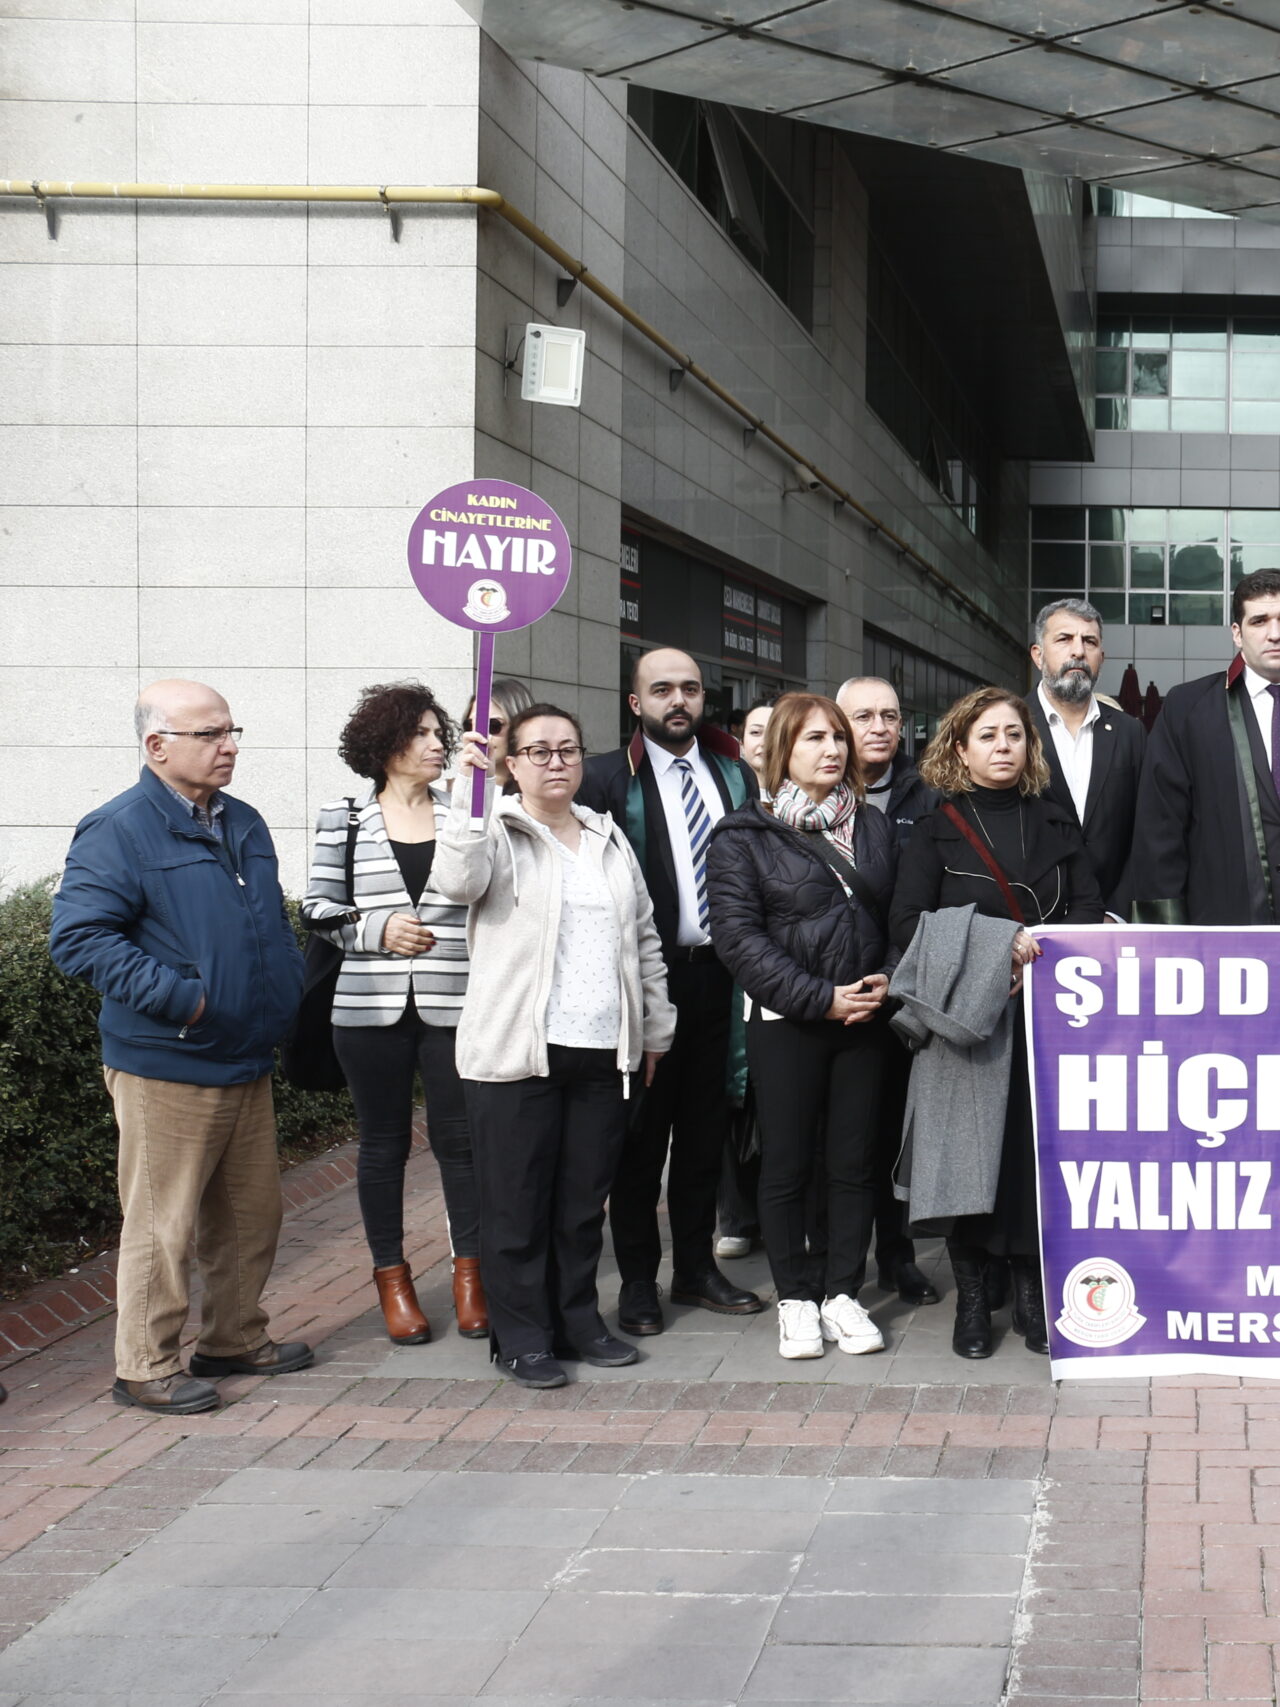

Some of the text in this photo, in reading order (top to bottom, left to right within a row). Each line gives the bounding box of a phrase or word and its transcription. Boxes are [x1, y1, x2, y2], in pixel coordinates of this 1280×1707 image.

[429, 507, 552, 531] CİNAYETLERİNE
[467, 493, 517, 510] KADIN
[421, 528, 557, 576] HAYIR
[1059, 1161, 1272, 1231] YALNIZ
